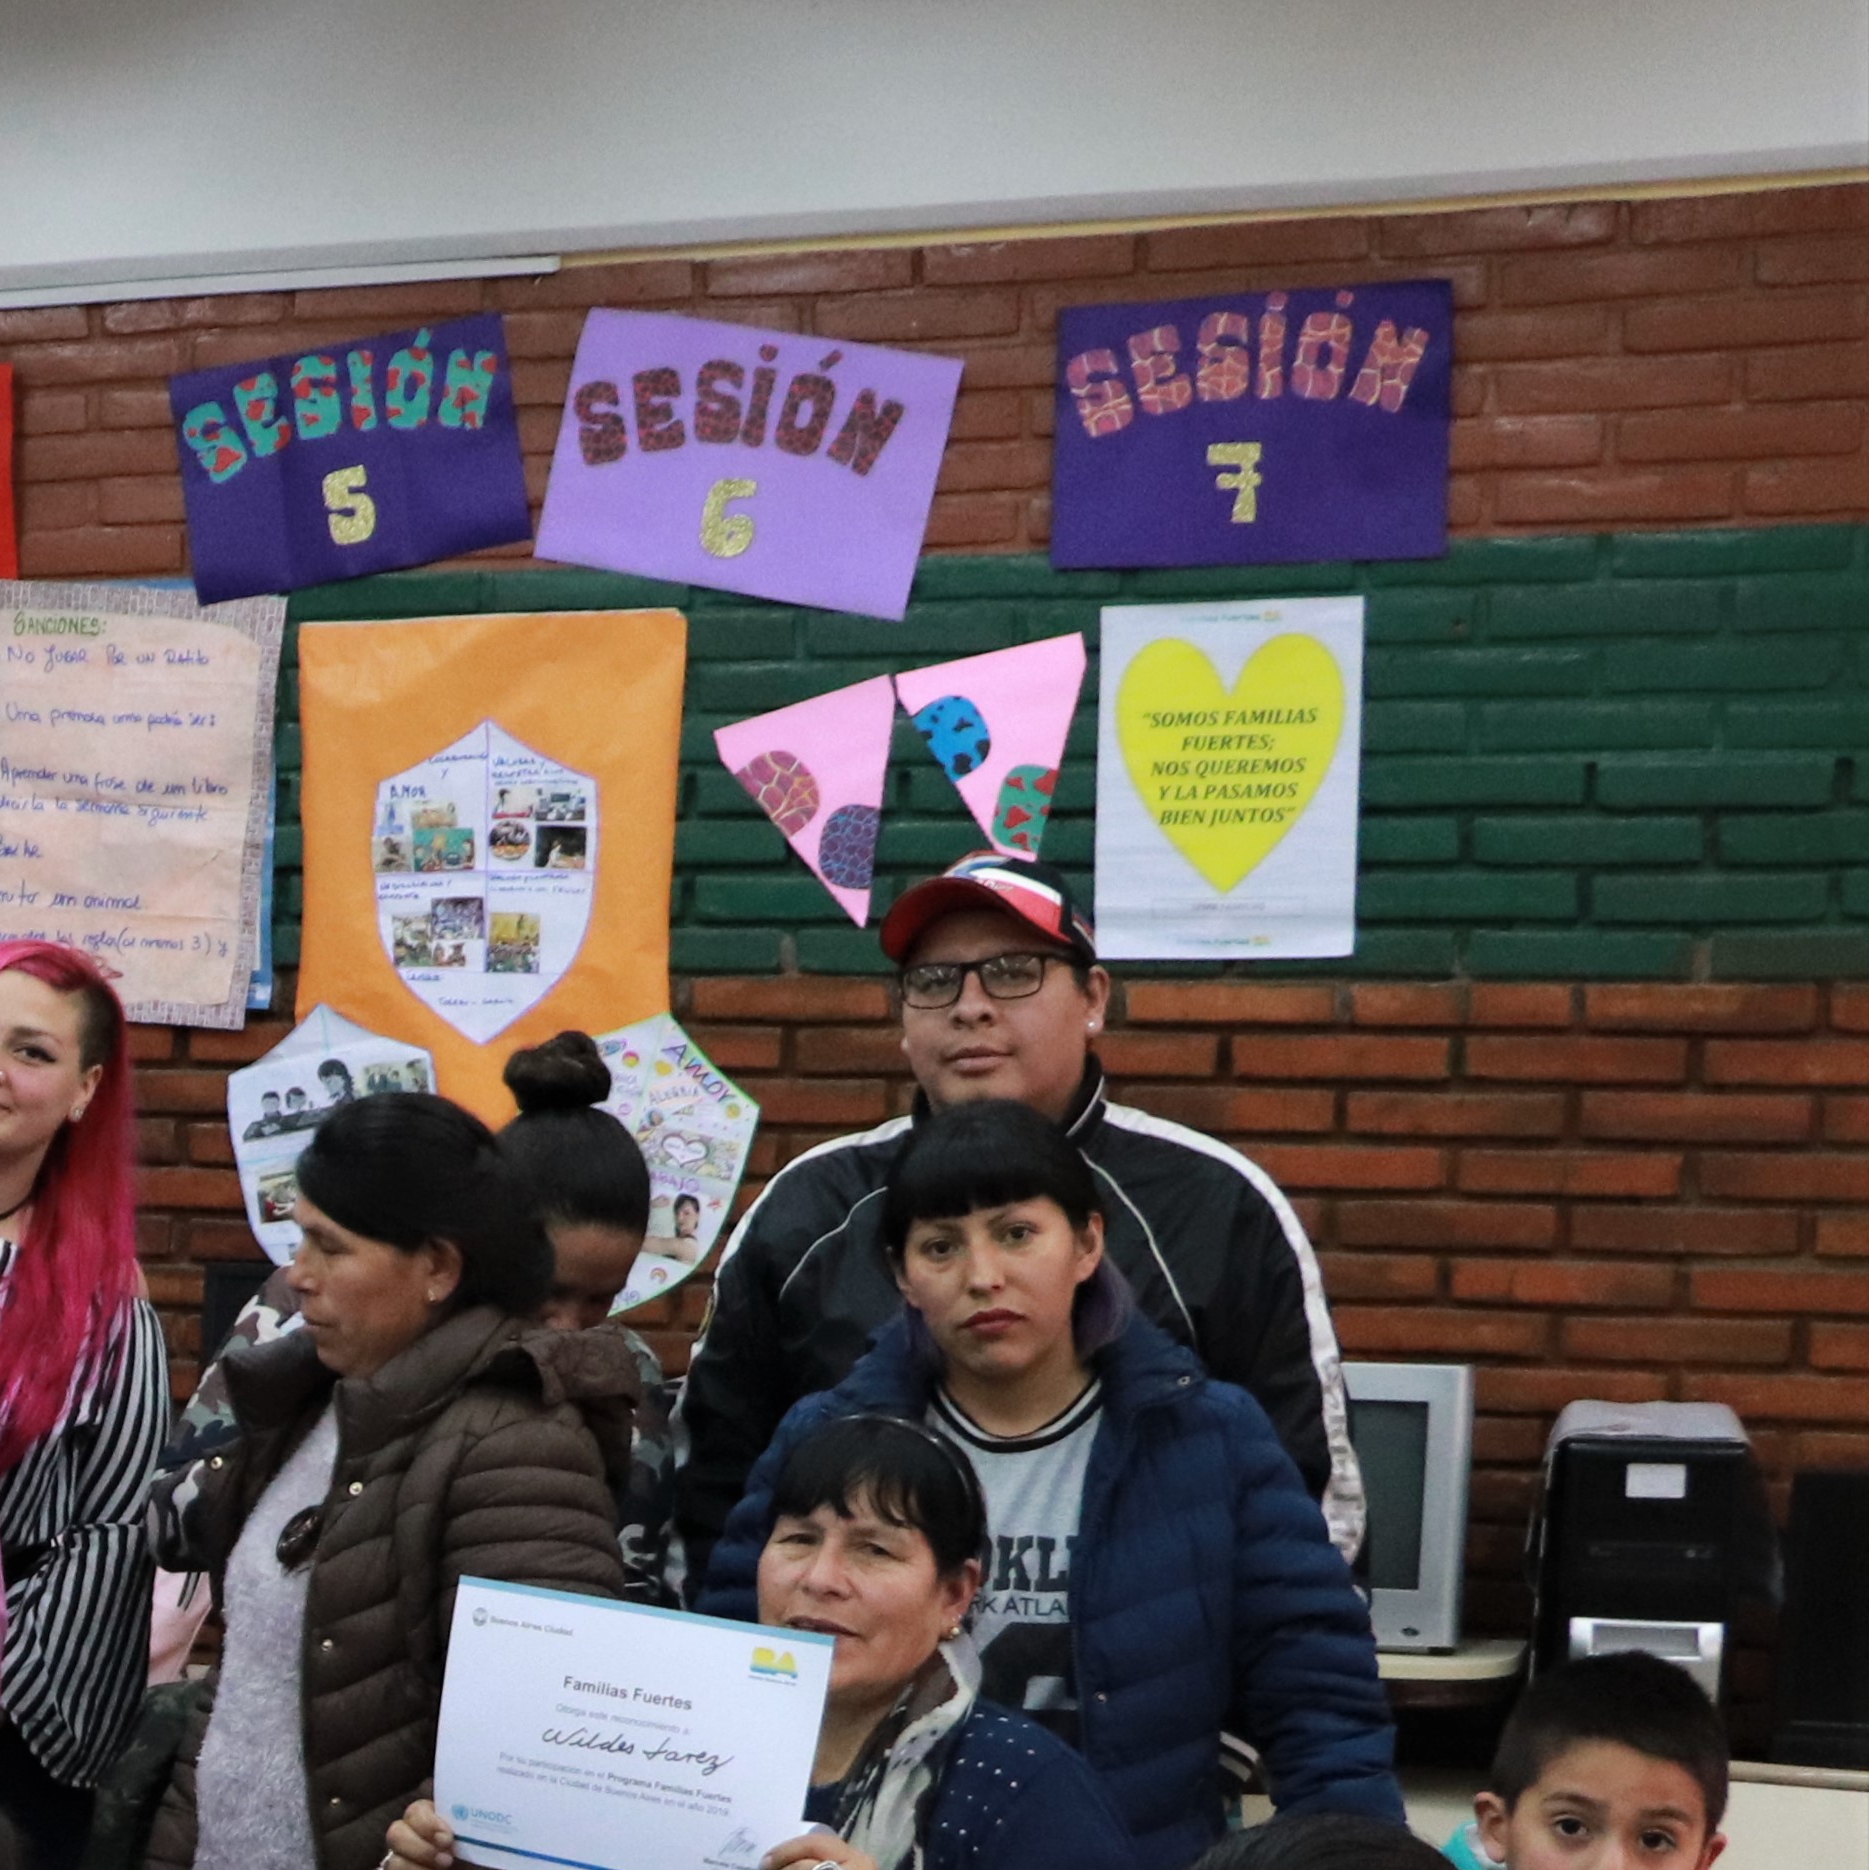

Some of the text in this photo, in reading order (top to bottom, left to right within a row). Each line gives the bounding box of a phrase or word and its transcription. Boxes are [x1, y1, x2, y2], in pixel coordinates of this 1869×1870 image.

[1066, 291, 1429, 438] SESIÓN
[182, 328, 498, 484] SESIÓN
[573, 344, 905, 476] SESIÓN
[322, 464, 377, 546] 5
[1207, 442, 1262, 523] 7
[700, 477, 759, 559] 6
[1222, 707, 1318, 726] FAMILIAS
[1150, 758, 1307, 779] NOS QUEREMOS
[1159, 782, 1299, 800] Y LA PASAMOS
[1159, 810, 1206, 826] BIEN
[563, 1675, 693, 1711] Familias Fuertes
[471, 1808, 513, 1826] UNODC
